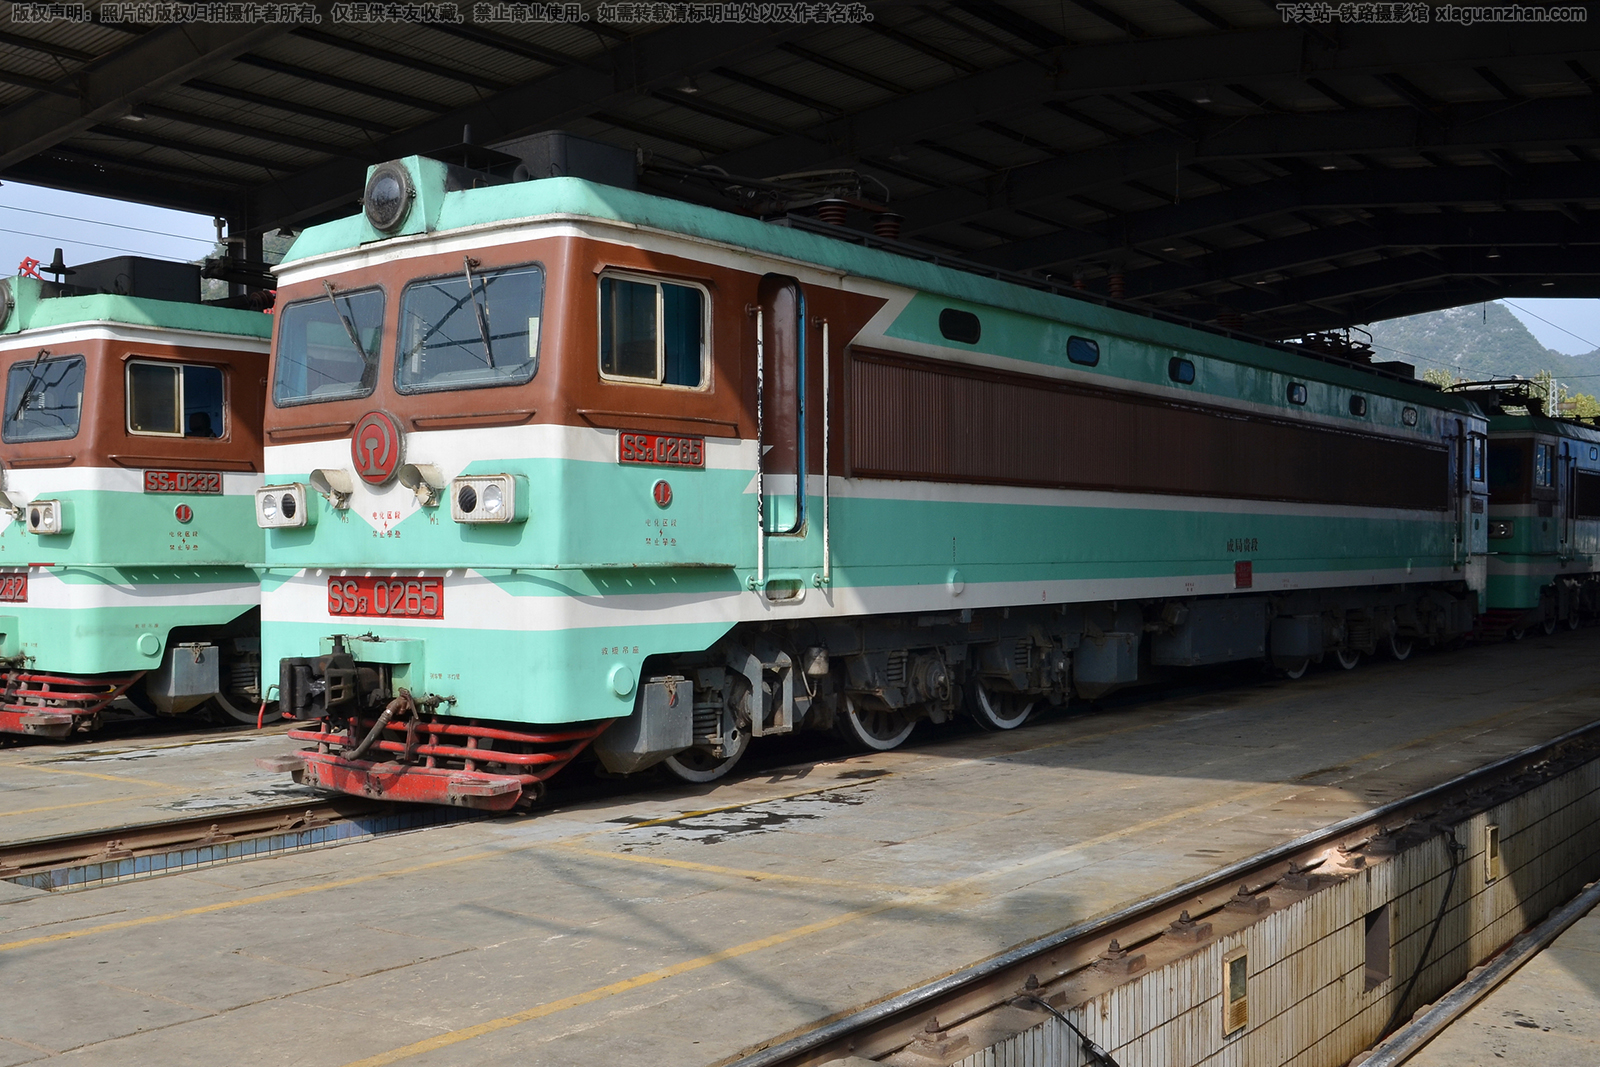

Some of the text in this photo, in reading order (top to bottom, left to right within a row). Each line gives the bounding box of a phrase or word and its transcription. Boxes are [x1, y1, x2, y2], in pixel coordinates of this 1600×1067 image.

[656, 437, 701, 464] 0265
[177, 473, 219, 491] 0232
[373, 581, 438, 615] 0265
